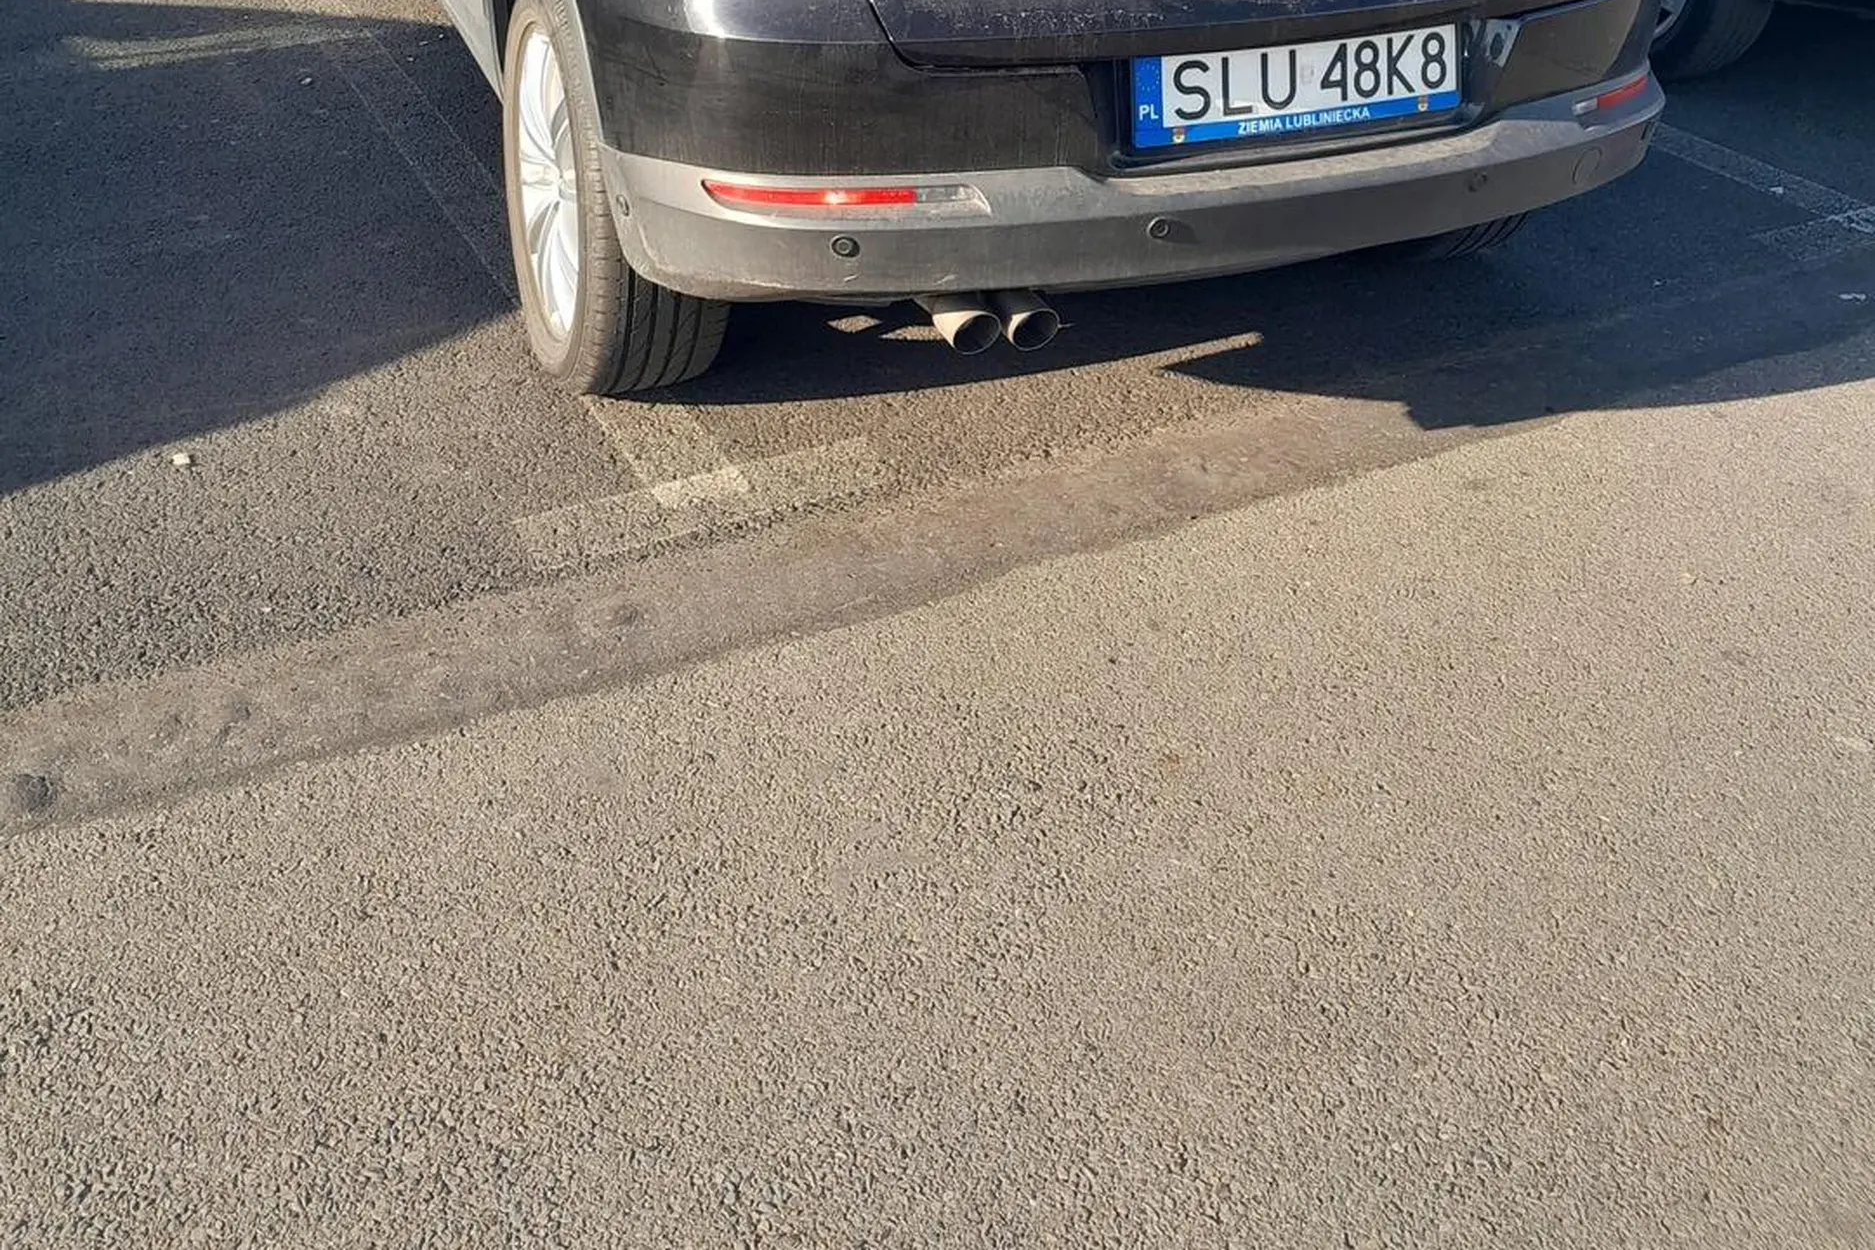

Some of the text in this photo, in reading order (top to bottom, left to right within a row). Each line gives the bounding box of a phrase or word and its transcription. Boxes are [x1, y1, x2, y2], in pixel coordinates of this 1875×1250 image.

[1173, 31, 1447, 121] SLU 48K8
[1139, 104, 1159, 121] PL
[1238, 106, 1371, 135] ZIEMIA LUBLINIECKA
